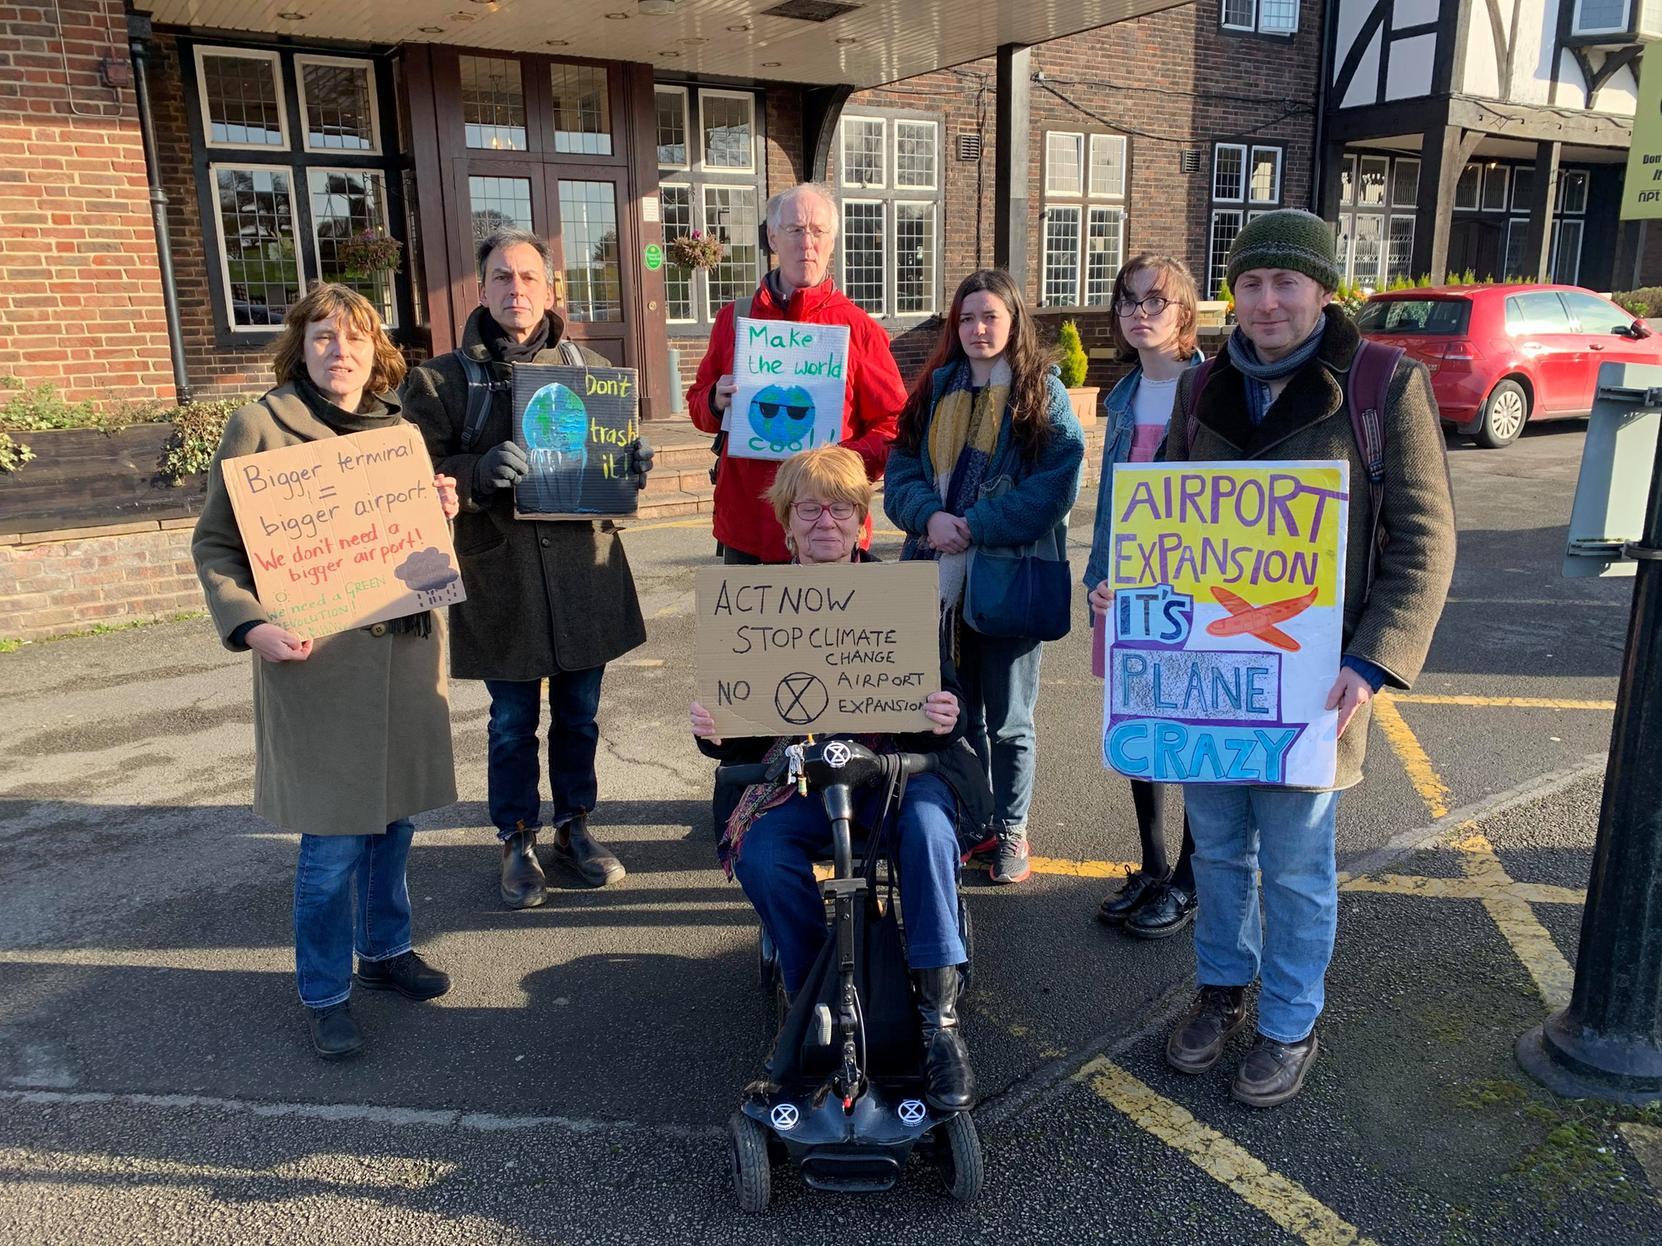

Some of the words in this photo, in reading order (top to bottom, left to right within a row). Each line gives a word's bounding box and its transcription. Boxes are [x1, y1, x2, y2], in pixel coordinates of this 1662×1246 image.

[749, 325, 813, 348] Make
[585, 371, 632, 397] Don't
[748, 354, 785, 374] the
[795, 352, 843, 379] world
[590, 417, 637, 447] trash
[243, 464, 322, 500] Bigger
[337, 439, 413, 473] terminal
[602, 453, 629, 480] it!
[260, 503, 340, 540] bigger
[1121, 474, 1349, 543] AIRPORT
[254, 549, 285, 572] We
[292, 537, 333, 564] don't
[339, 523, 378, 550] need
[388, 522, 400, 535] a
[290, 557, 343, 585] bigger
[354, 528, 424, 564] airport!
[1115, 532, 1318, 585] EXPANSION
[291, 593, 326, 614] need
[345, 576, 386, 598] GREEN
[715, 580, 772, 615] ACT
[779, 587, 855, 614] NOW
[1120, 590, 1186, 640] IT'S
[733, 626, 802, 654] STOP
[809, 628, 897, 648] CLIMATE
[825, 651, 895, 665] CHANGE
[718, 680, 750, 705] NO
[838, 672, 924, 688] AIRPORT
[1122, 653, 1269, 714] PLANE
[1107, 722, 1293, 781] CRAZY
